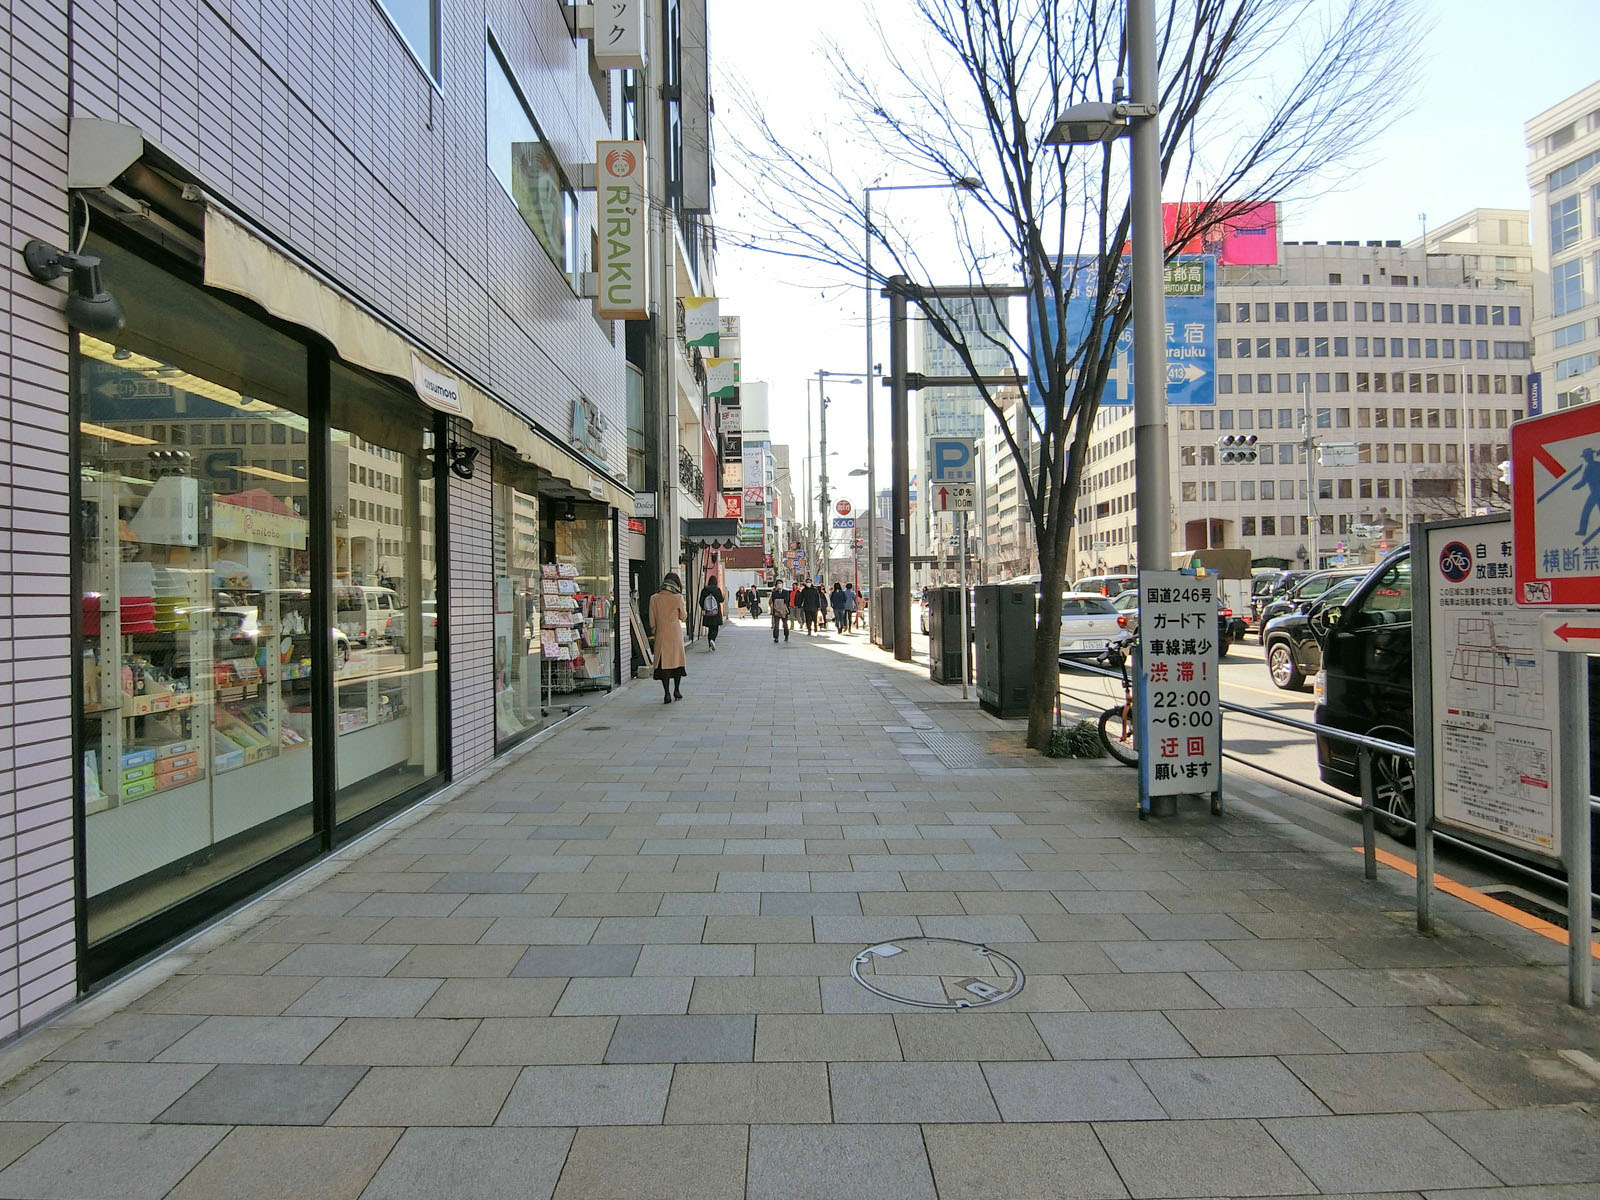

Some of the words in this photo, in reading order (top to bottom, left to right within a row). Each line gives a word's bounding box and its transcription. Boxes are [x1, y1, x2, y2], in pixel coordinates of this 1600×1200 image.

[1168, 368, 1184, 379] 413
[936, 442, 969, 479] P
[952, 488, 972, 496] この先
[954, 498, 972, 507] 100m
[1476, 562, 1513, 580] 放置禁
[1147, 587, 1212, 604] 国道246号
[1153, 612, 1206, 629] ガード下
[1150, 638, 1212, 656] 車線減少
[1153, 690, 1211, 708] 22:00
[1155, 761, 1212, 781] 願います
